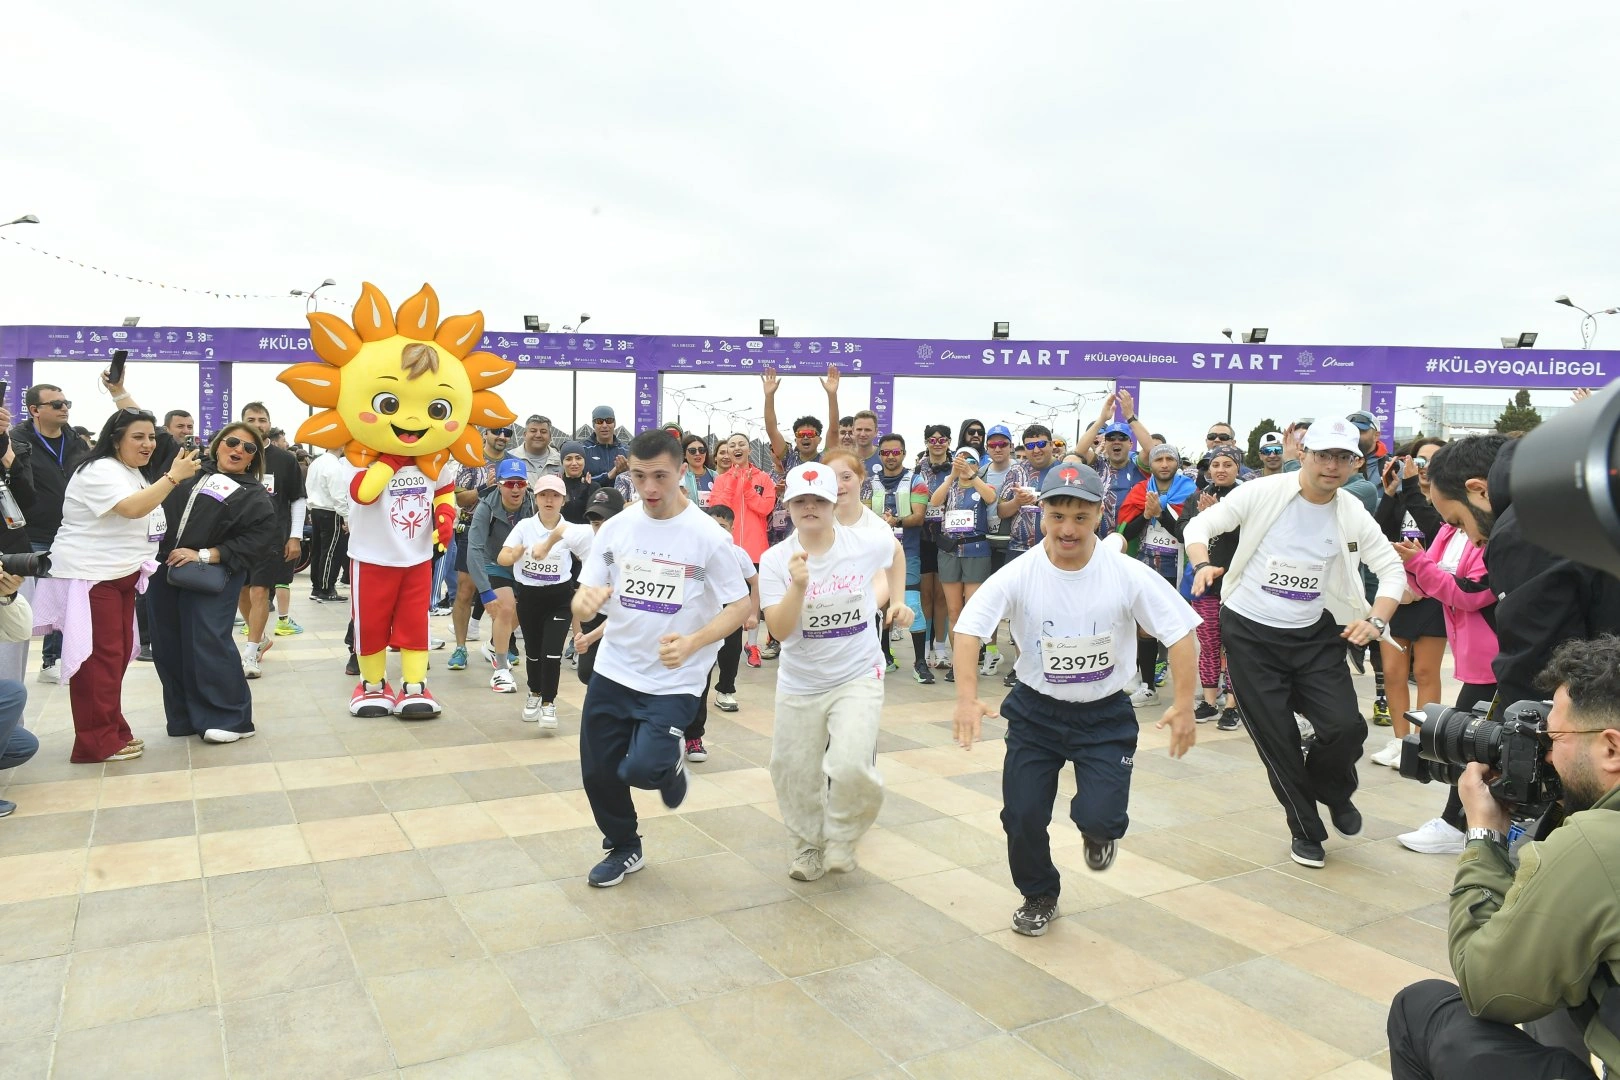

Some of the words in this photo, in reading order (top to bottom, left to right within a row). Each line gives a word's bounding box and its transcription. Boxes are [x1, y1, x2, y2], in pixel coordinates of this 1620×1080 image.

[982, 348, 1070, 366] START
[1083, 351, 1179, 364] #KÜLƏYƏQALİBGƏL
[1191, 352, 1283, 371] START
[1425, 356, 1606, 376] #KÜLƏYƏQALİBGƏL
[391, 476, 425, 488] 20030
[925, 509, 940, 517] 623
[950, 518, 966, 526] 620
[1152, 536, 1171, 546] 663
[524, 560, 559, 573] 23983
[624, 578, 676, 600] 23977
[1268, 572, 1319, 590] 23982
[809, 608, 862, 629] 23974
[1049, 651, 1109, 671] 23975
